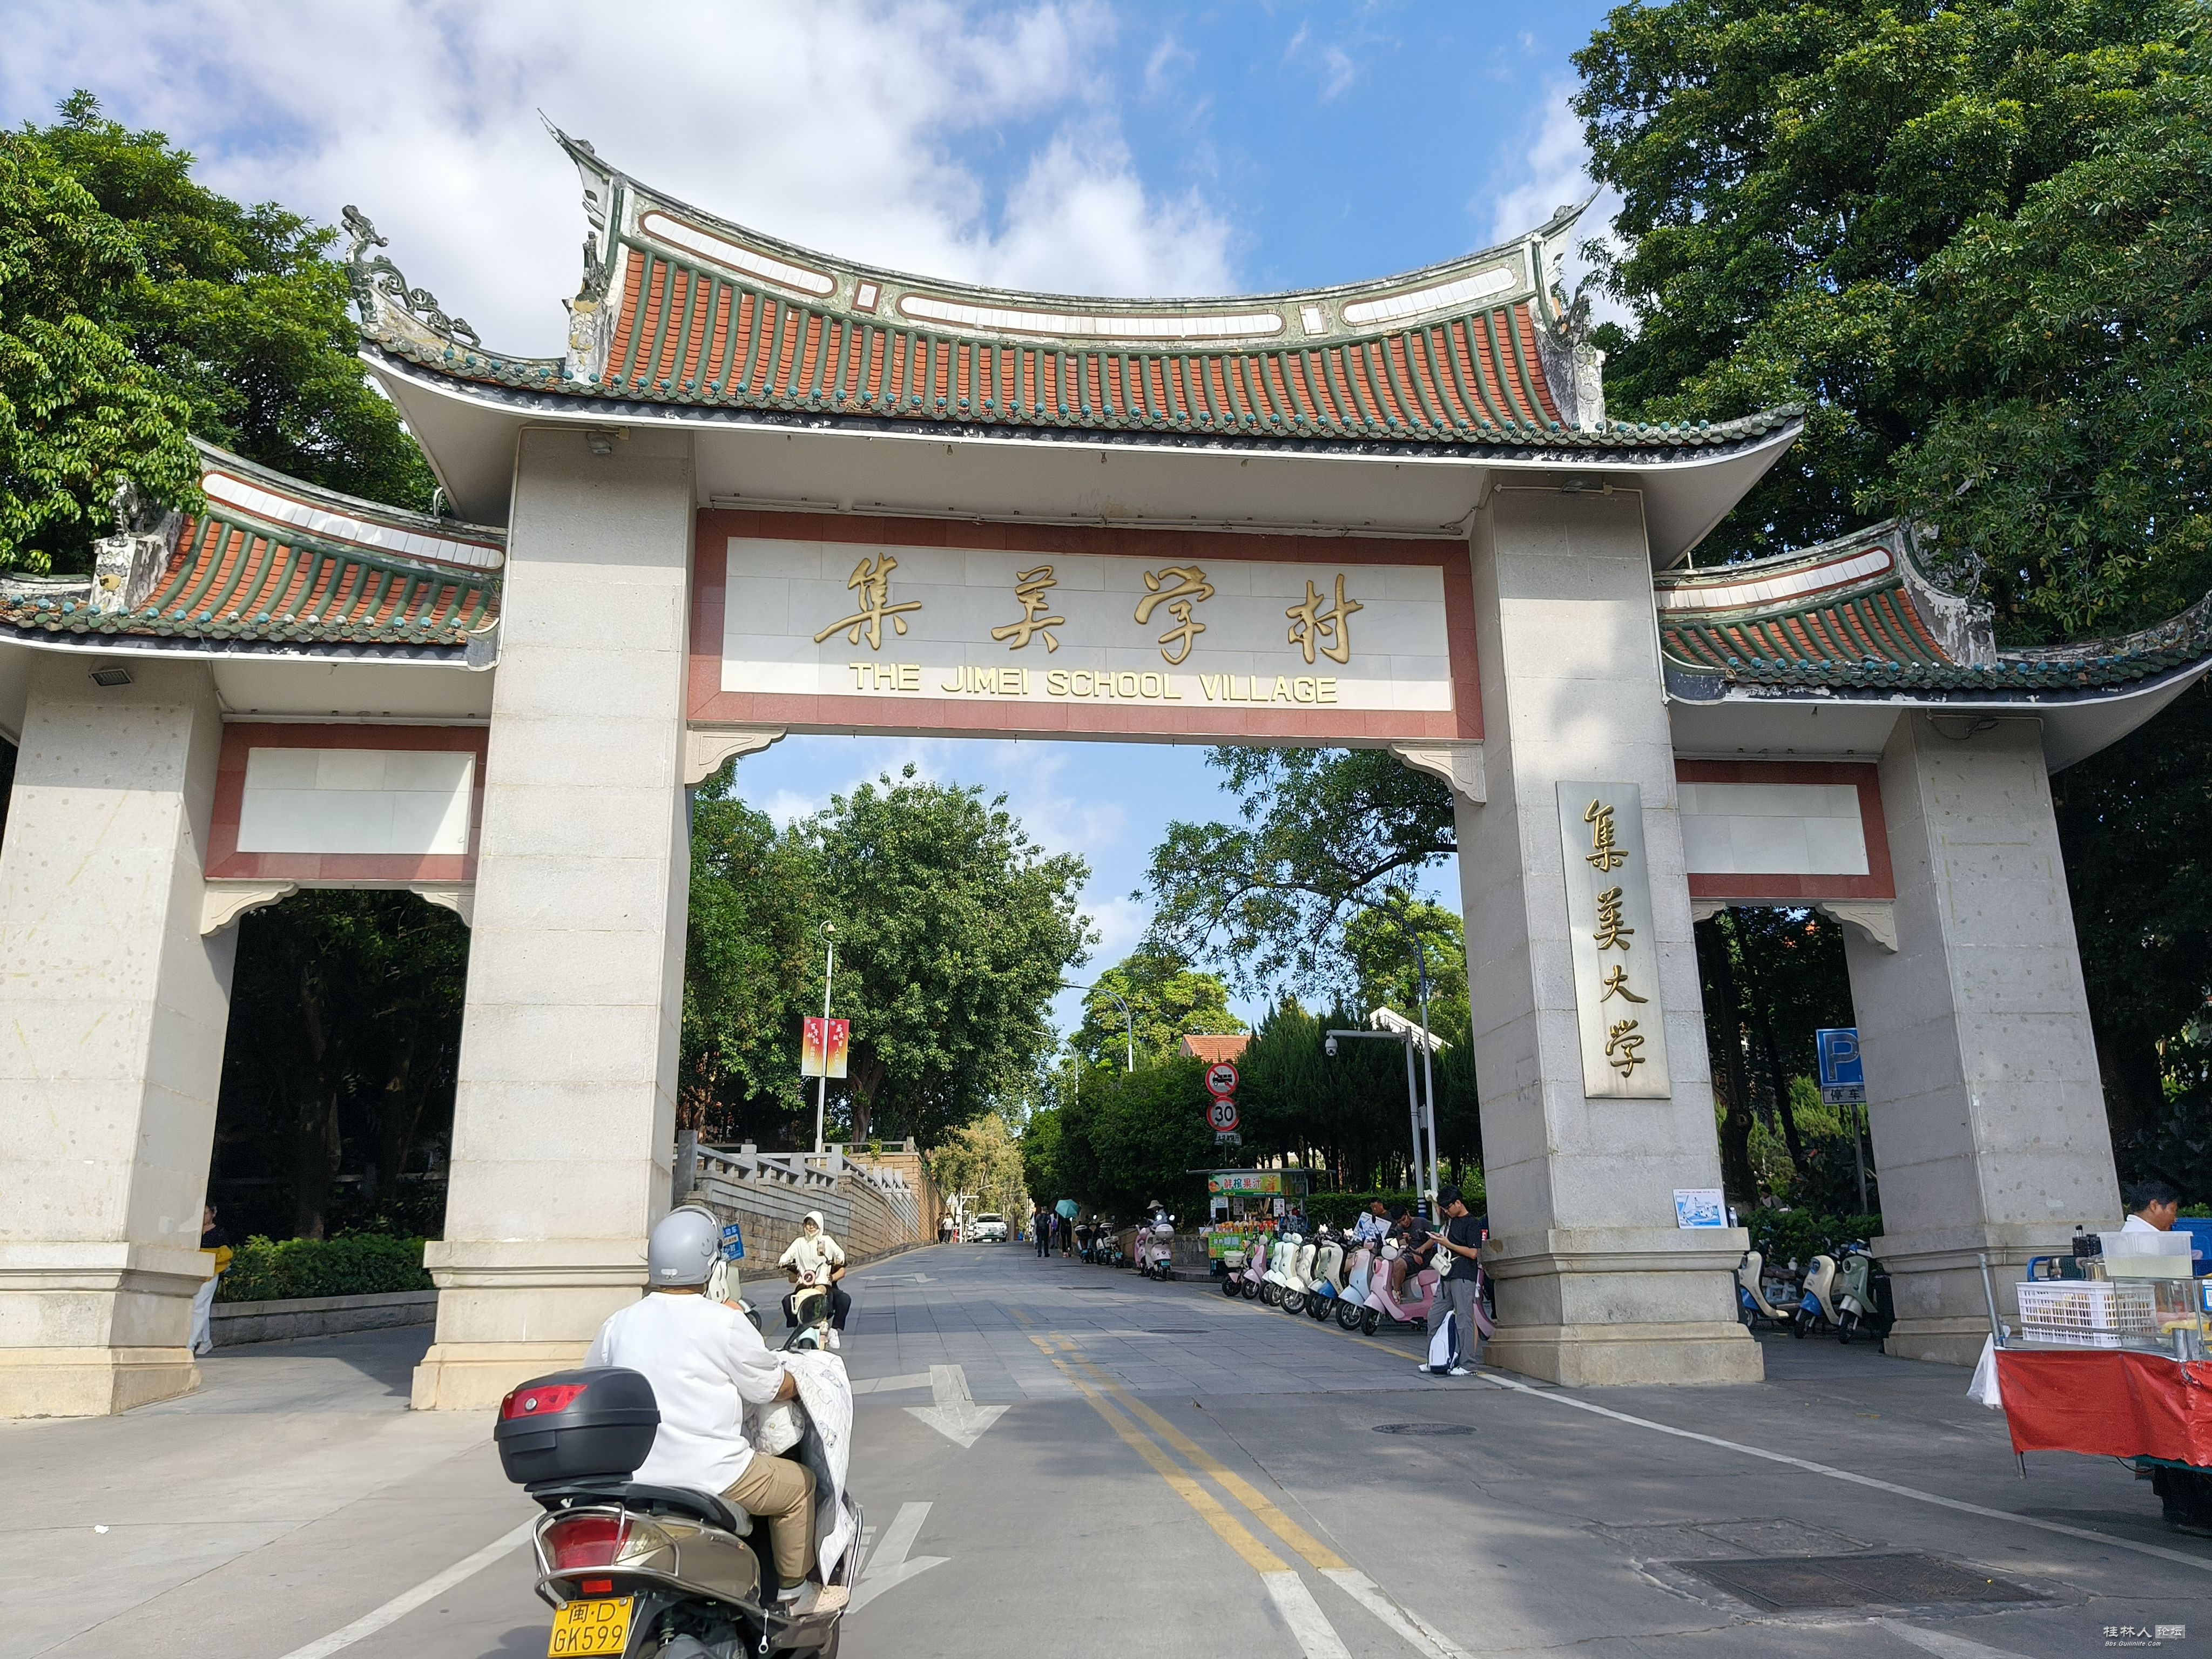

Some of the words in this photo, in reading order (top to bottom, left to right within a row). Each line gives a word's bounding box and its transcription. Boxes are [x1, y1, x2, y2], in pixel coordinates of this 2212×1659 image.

[813, 552, 1364, 665] 集美学村
[849, 662, 921, 691] THE
[941, 665, 1029, 694] JIMEI
[1047, 669, 1182, 700] SCHOOL
[1199, 672, 1338, 705] VILLAGE
[1583, 798, 1649, 1078] 集美大学
[1823, 1032, 1860, 1081] P
[1215, 1105, 1233, 1122] 30
[1223, 1178, 1262, 1189] 鲜榨果汁
[569, 1603, 616, 1624] 闽·D
[554, 1625, 623, 1652] GK599
